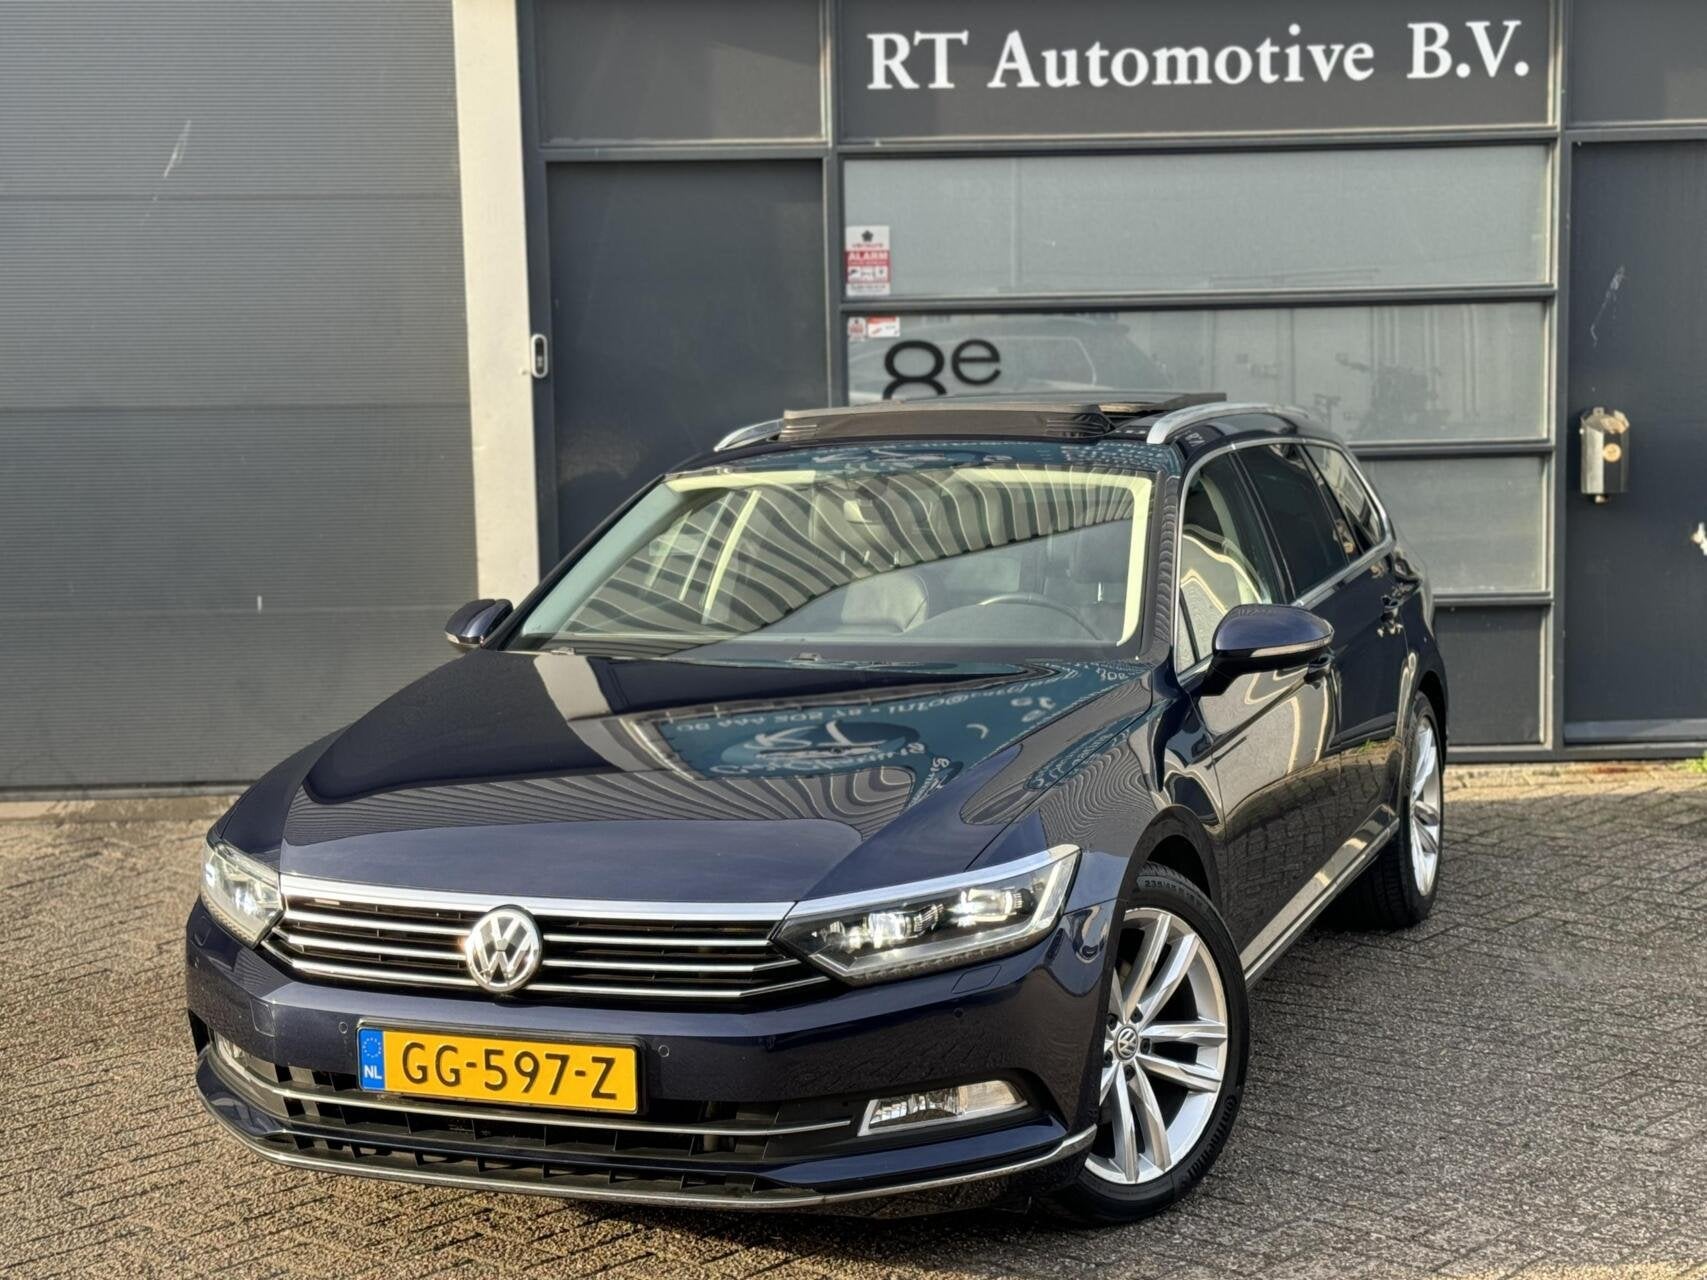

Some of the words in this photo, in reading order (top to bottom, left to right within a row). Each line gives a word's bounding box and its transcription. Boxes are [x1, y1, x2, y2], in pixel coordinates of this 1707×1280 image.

[866, 29, 969, 90] RT
[986, 23, 1375, 88] Automotive
[1406, 19, 1530, 79] B.V.
[466, 908, 541, 990] VW
[364, 1065, 382, 1080] NL
[402, 1041, 618, 1100] GG-597-Z
